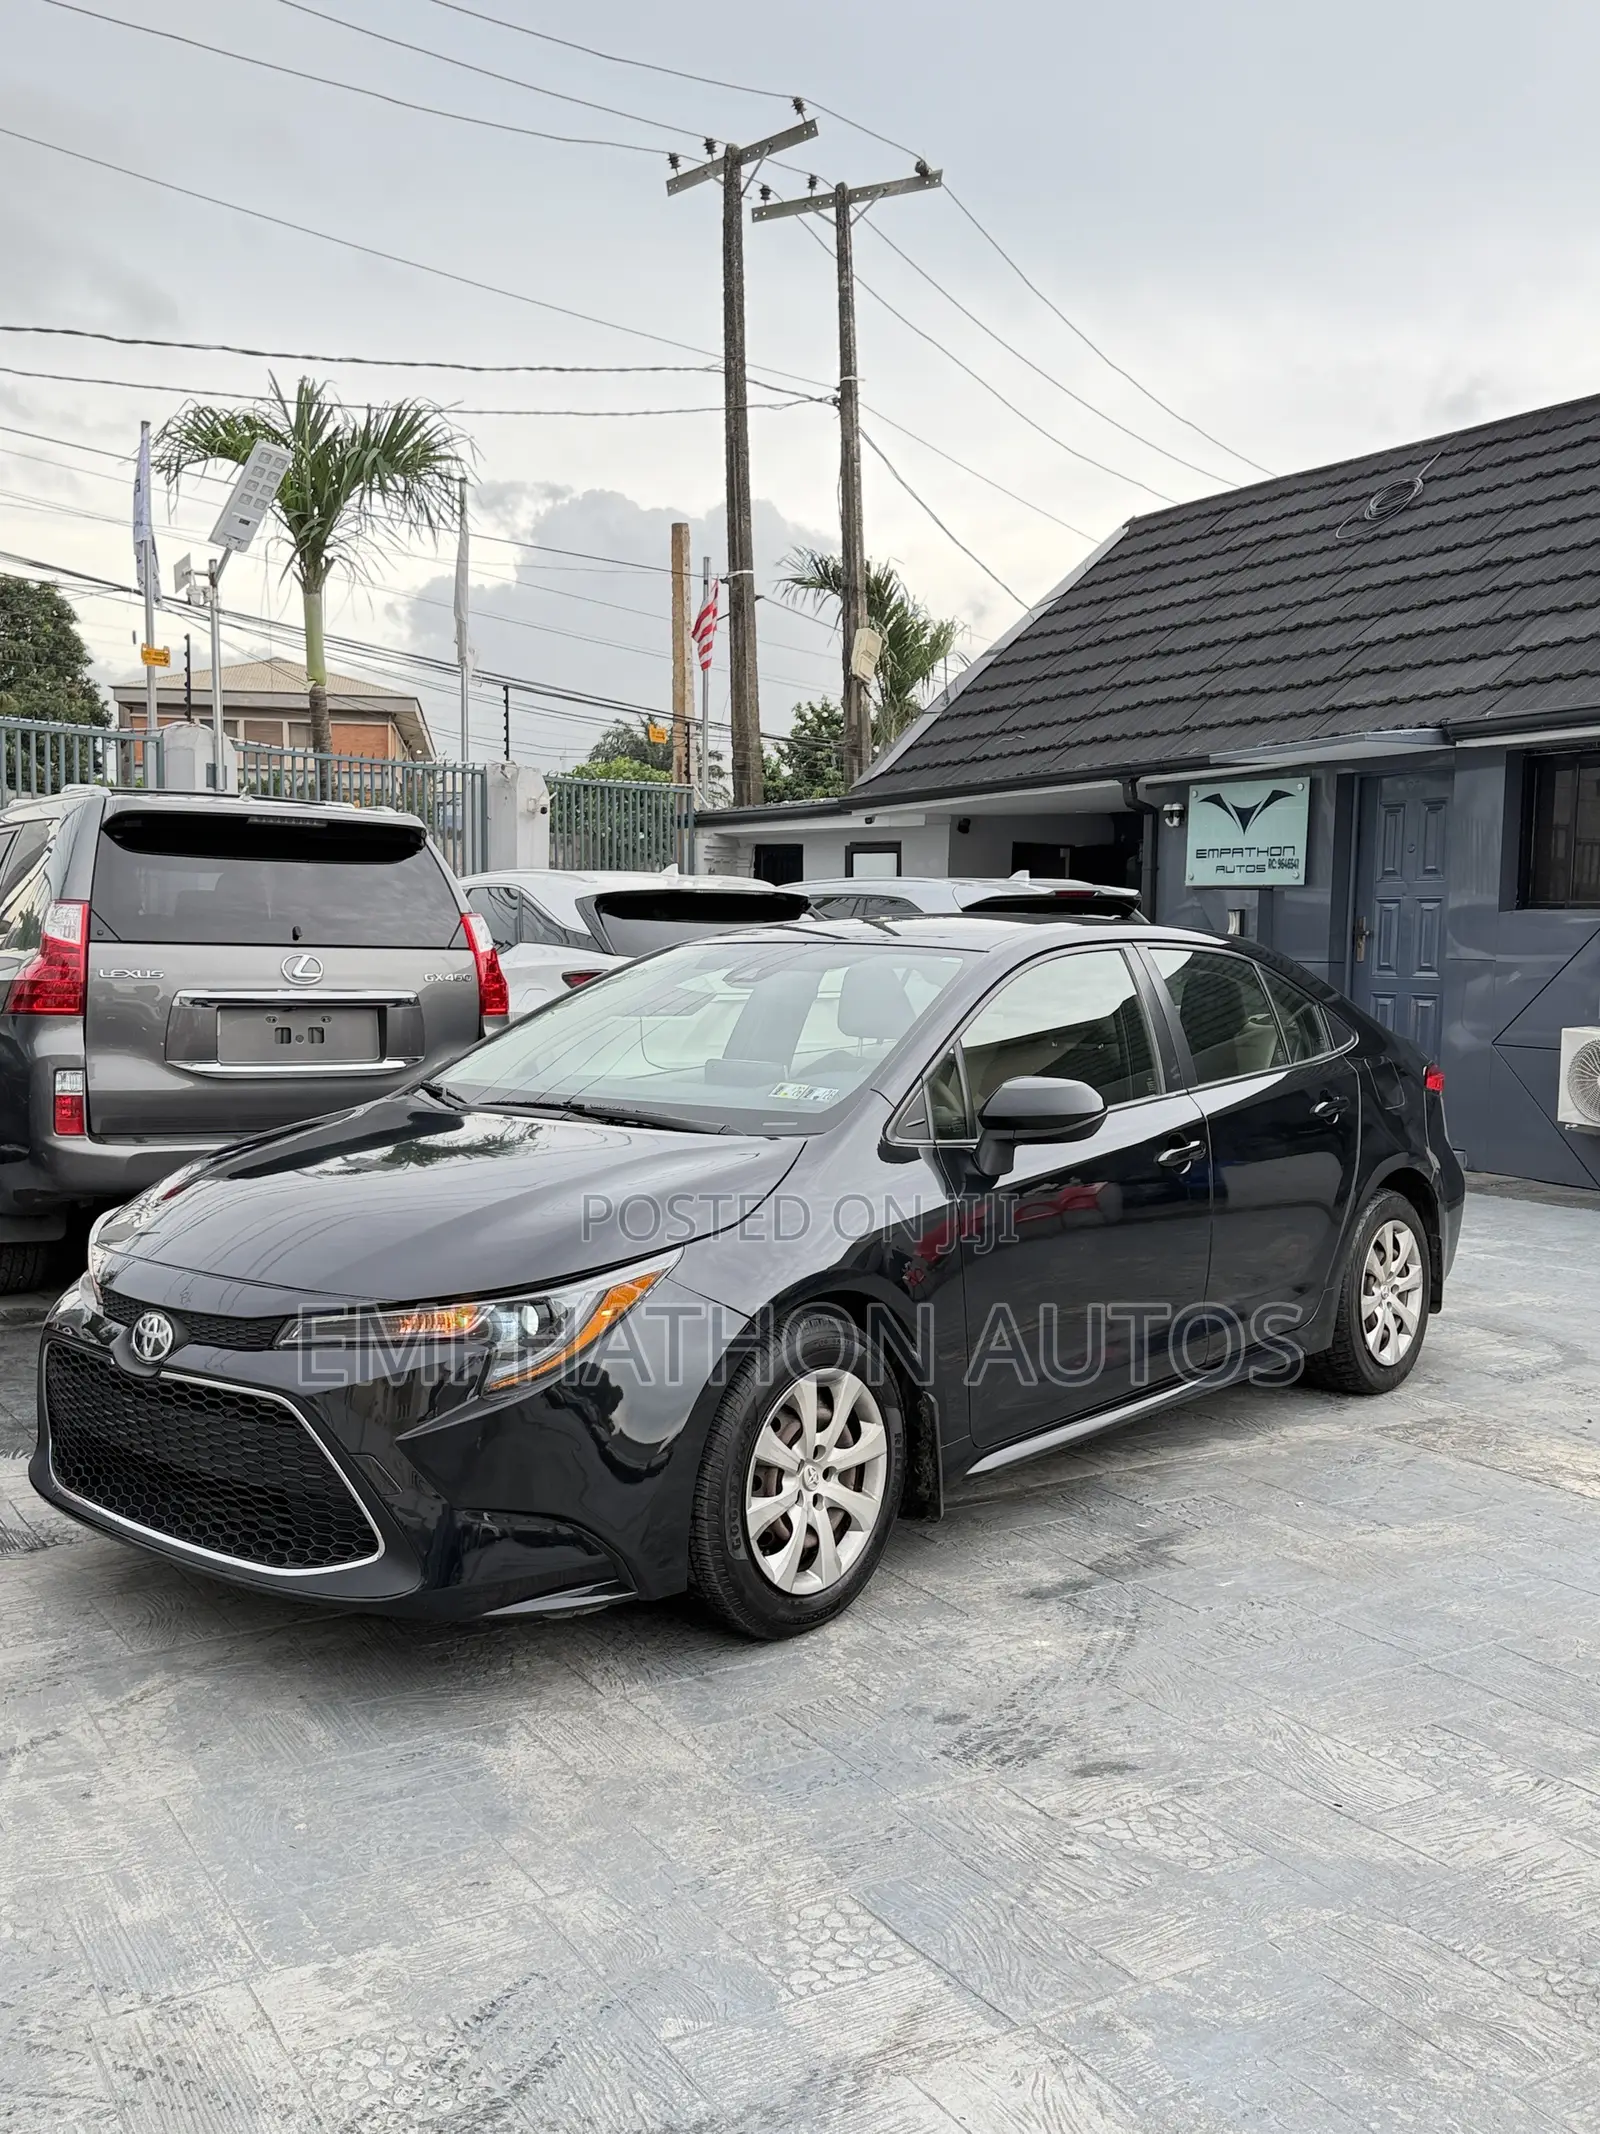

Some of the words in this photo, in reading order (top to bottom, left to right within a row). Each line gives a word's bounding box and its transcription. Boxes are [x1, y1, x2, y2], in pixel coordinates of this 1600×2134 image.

[1195, 845, 1296, 859] EMPATHON
[1215, 864, 1266, 874] AUTOS
[99, 969, 165, 980] LEXUS
